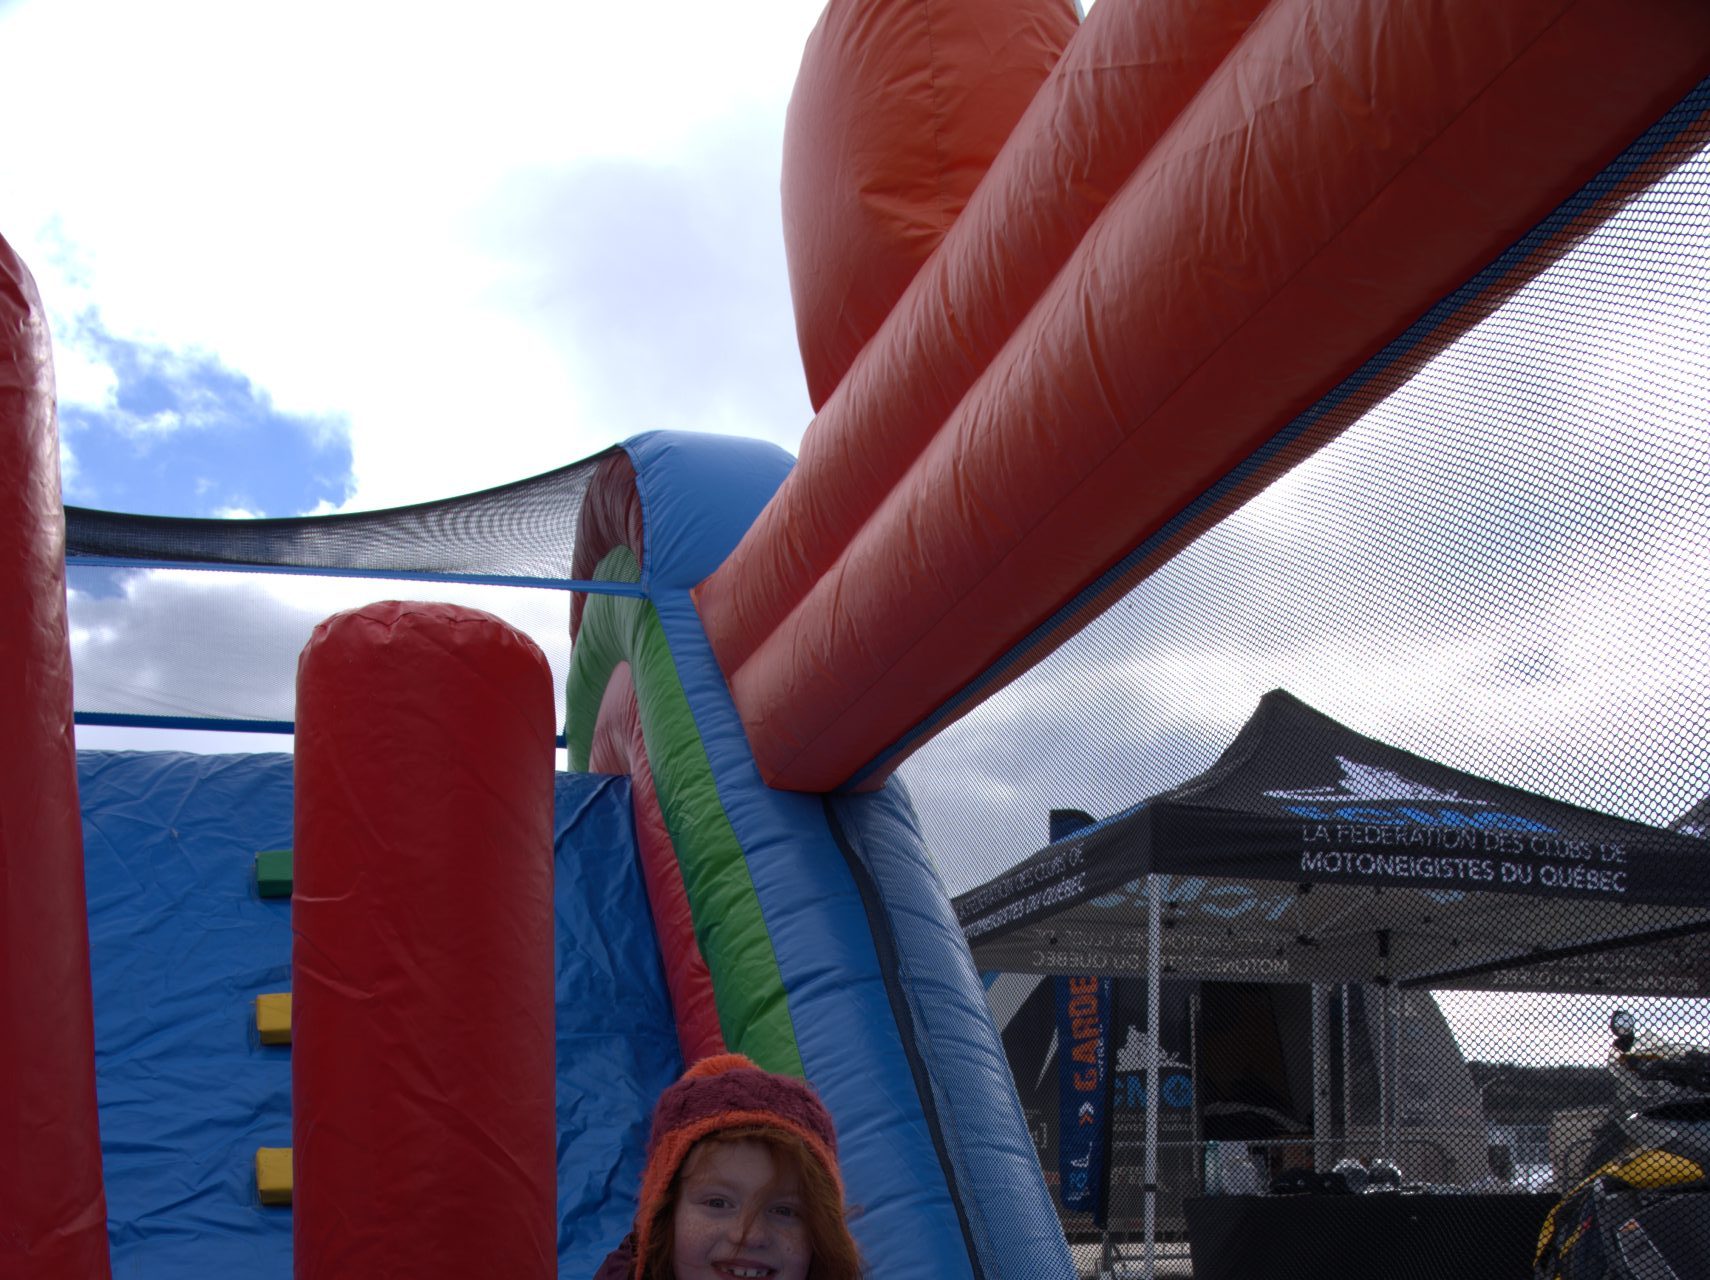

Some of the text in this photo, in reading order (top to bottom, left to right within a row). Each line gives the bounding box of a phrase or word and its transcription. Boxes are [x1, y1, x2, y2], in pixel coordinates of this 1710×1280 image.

[1302, 824, 1331, 844] LA
[1484, 831, 1525, 855] DES
[1531, 837, 1593, 861] CLUBS
[1600, 842, 1627, 865] DE
[1300, 851, 1495, 882] MOTONEIGISTES
[1501, 862, 1533, 884] DU
